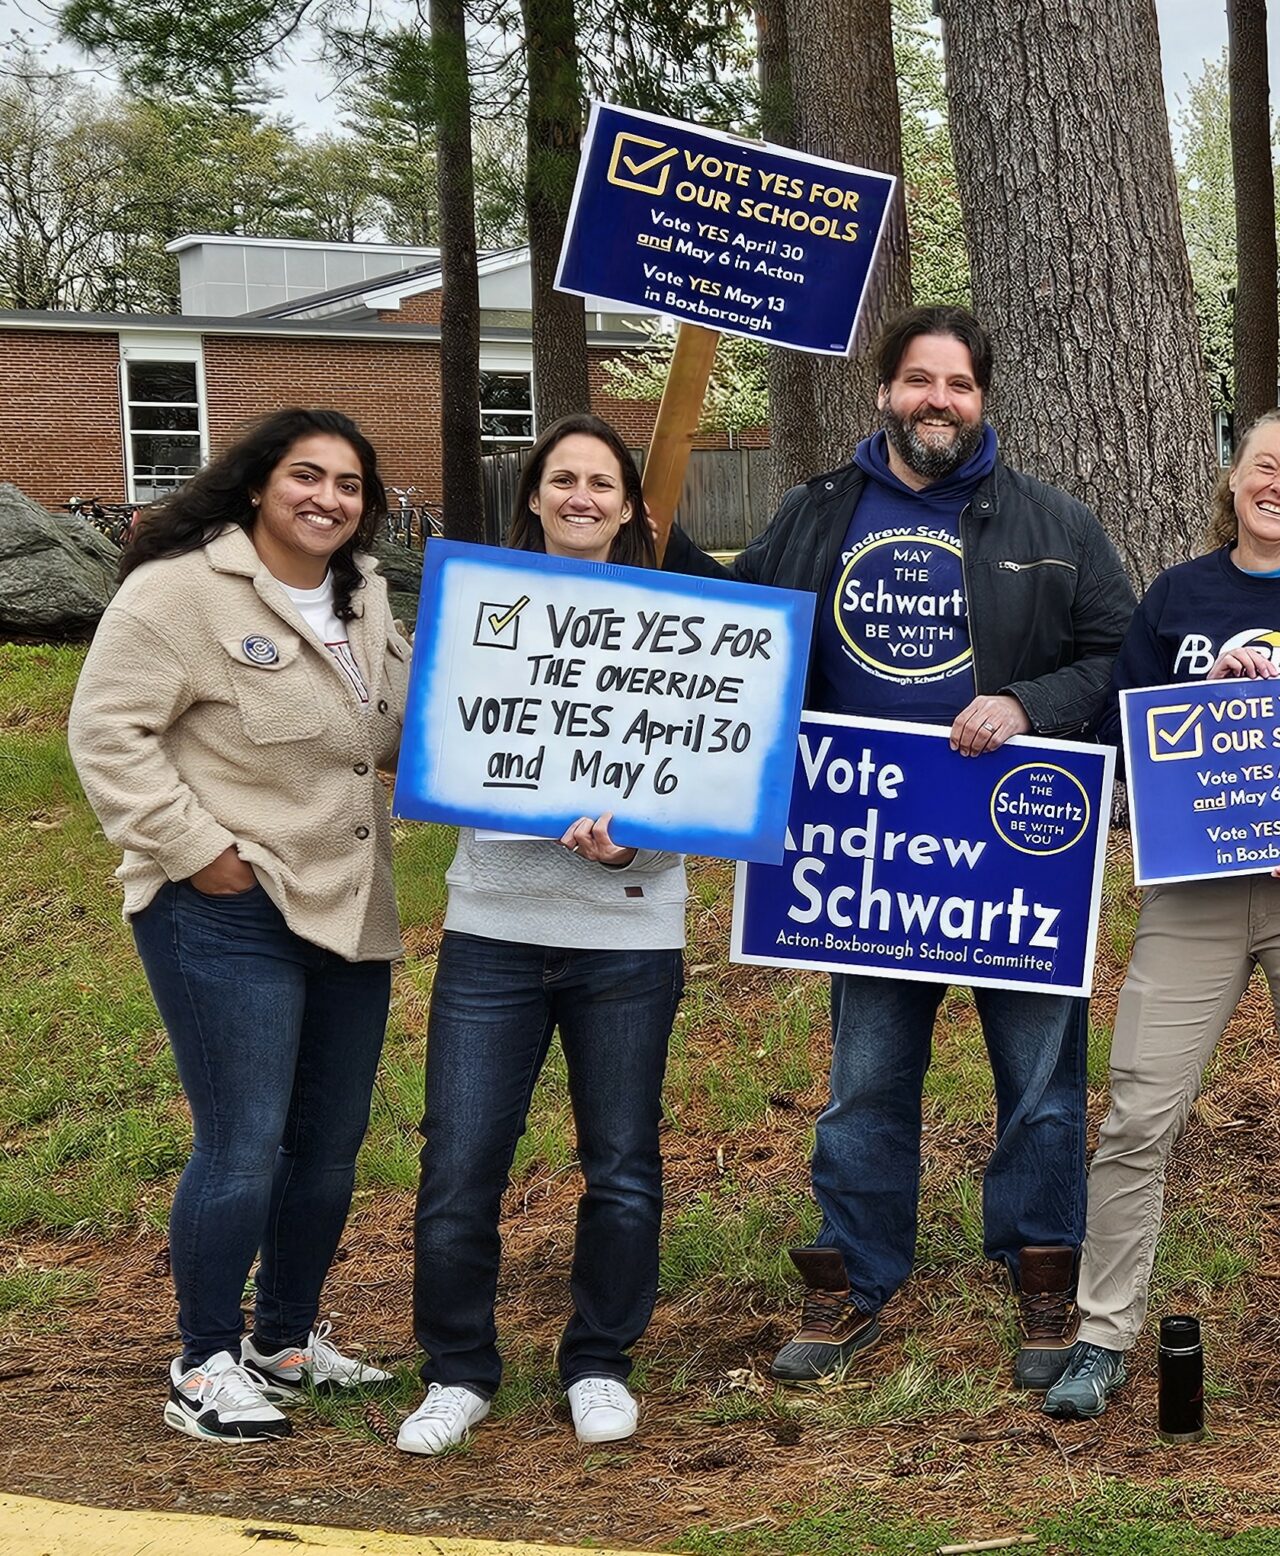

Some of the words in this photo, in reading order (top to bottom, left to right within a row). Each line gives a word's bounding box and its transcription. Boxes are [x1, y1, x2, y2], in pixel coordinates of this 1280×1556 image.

[684, 150, 749, 186] VOTE
[758, 170, 804, 198] YES
[810, 184, 859, 212] FOR
[675, 181, 730, 213] OUR
[737, 199, 859, 241] SCHOOLS
[650, 209, 691, 232] Vote
[696, 222, 729, 242] YES
[732, 233, 777, 256] April
[780, 244, 804, 260] 30
[637, 232, 672, 252] and
[676, 239, 715, 264] May
[719, 250, 730, 265] 6
[734, 254, 750, 270] in
[754, 260, 804, 283] Acton
[642, 263, 683, 287] Vote
[688, 276, 720, 296] YES
[724, 285, 763, 310] May
[766, 295, 785, 312] 13
[645, 285, 659, 301] in
[665, 292, 772, 331] Boxborough
[841, 527, 911, 565] Andrew
[916, 526, 962, 548] Schw
[893, 548, 932, 563] MAY
[894, 568, 928, 582] THE
[546, 603, 625, 650] VOTE
[632, 611, 705, 655] YES
[710, 624, 773, 660] FOR
[865, 624, 889, 638] BE
[898, 626, 953, 640] WITH
[888, 643, 933, 658] YOU
[528, 654, 587, 688] THE
[596, 665, 743, 703] OVERRIDE
[1208, 697, 1274, 722] VOTE
[458, 696, 541, 735] VOTE
[552, 699, 614, 738] YES
[622, 709, 705, 755] April
[706, 717, 751, 753] 30
[1212, 729, 1266, 754] OUR
[482, 746, 545, 790] and
[570, 749, 644, 799] May
[654, 757, 678, 795] 6
[798, 734, 905, 800] Vote
[1030, 773, 1054, 783] MAY
[1197, 771, 1237, 787] Vote
[1241, 766, 1274, 780] YES
[1031, 785, 1052, 796] THE
[1193, 796, 1225, 812] and
[1230, 790, 1266, 807] May
[996, 793, 1082, 821] Schwartz
[1011, 821, 1027, 831] BE
[1031, 823, 1064, 835] WITH
[1024, 833, 1052, 845] YOU
[1206, 827, 1247, 843] Vote
[1216, 849, 1232, 864] in
[787, 856, 1061, 948] Schwartz
[776, 930, 914, 959] Acton-Boxborough
[920, 943, 967, 963] School
[973, 949, 1052, 972] Committee
